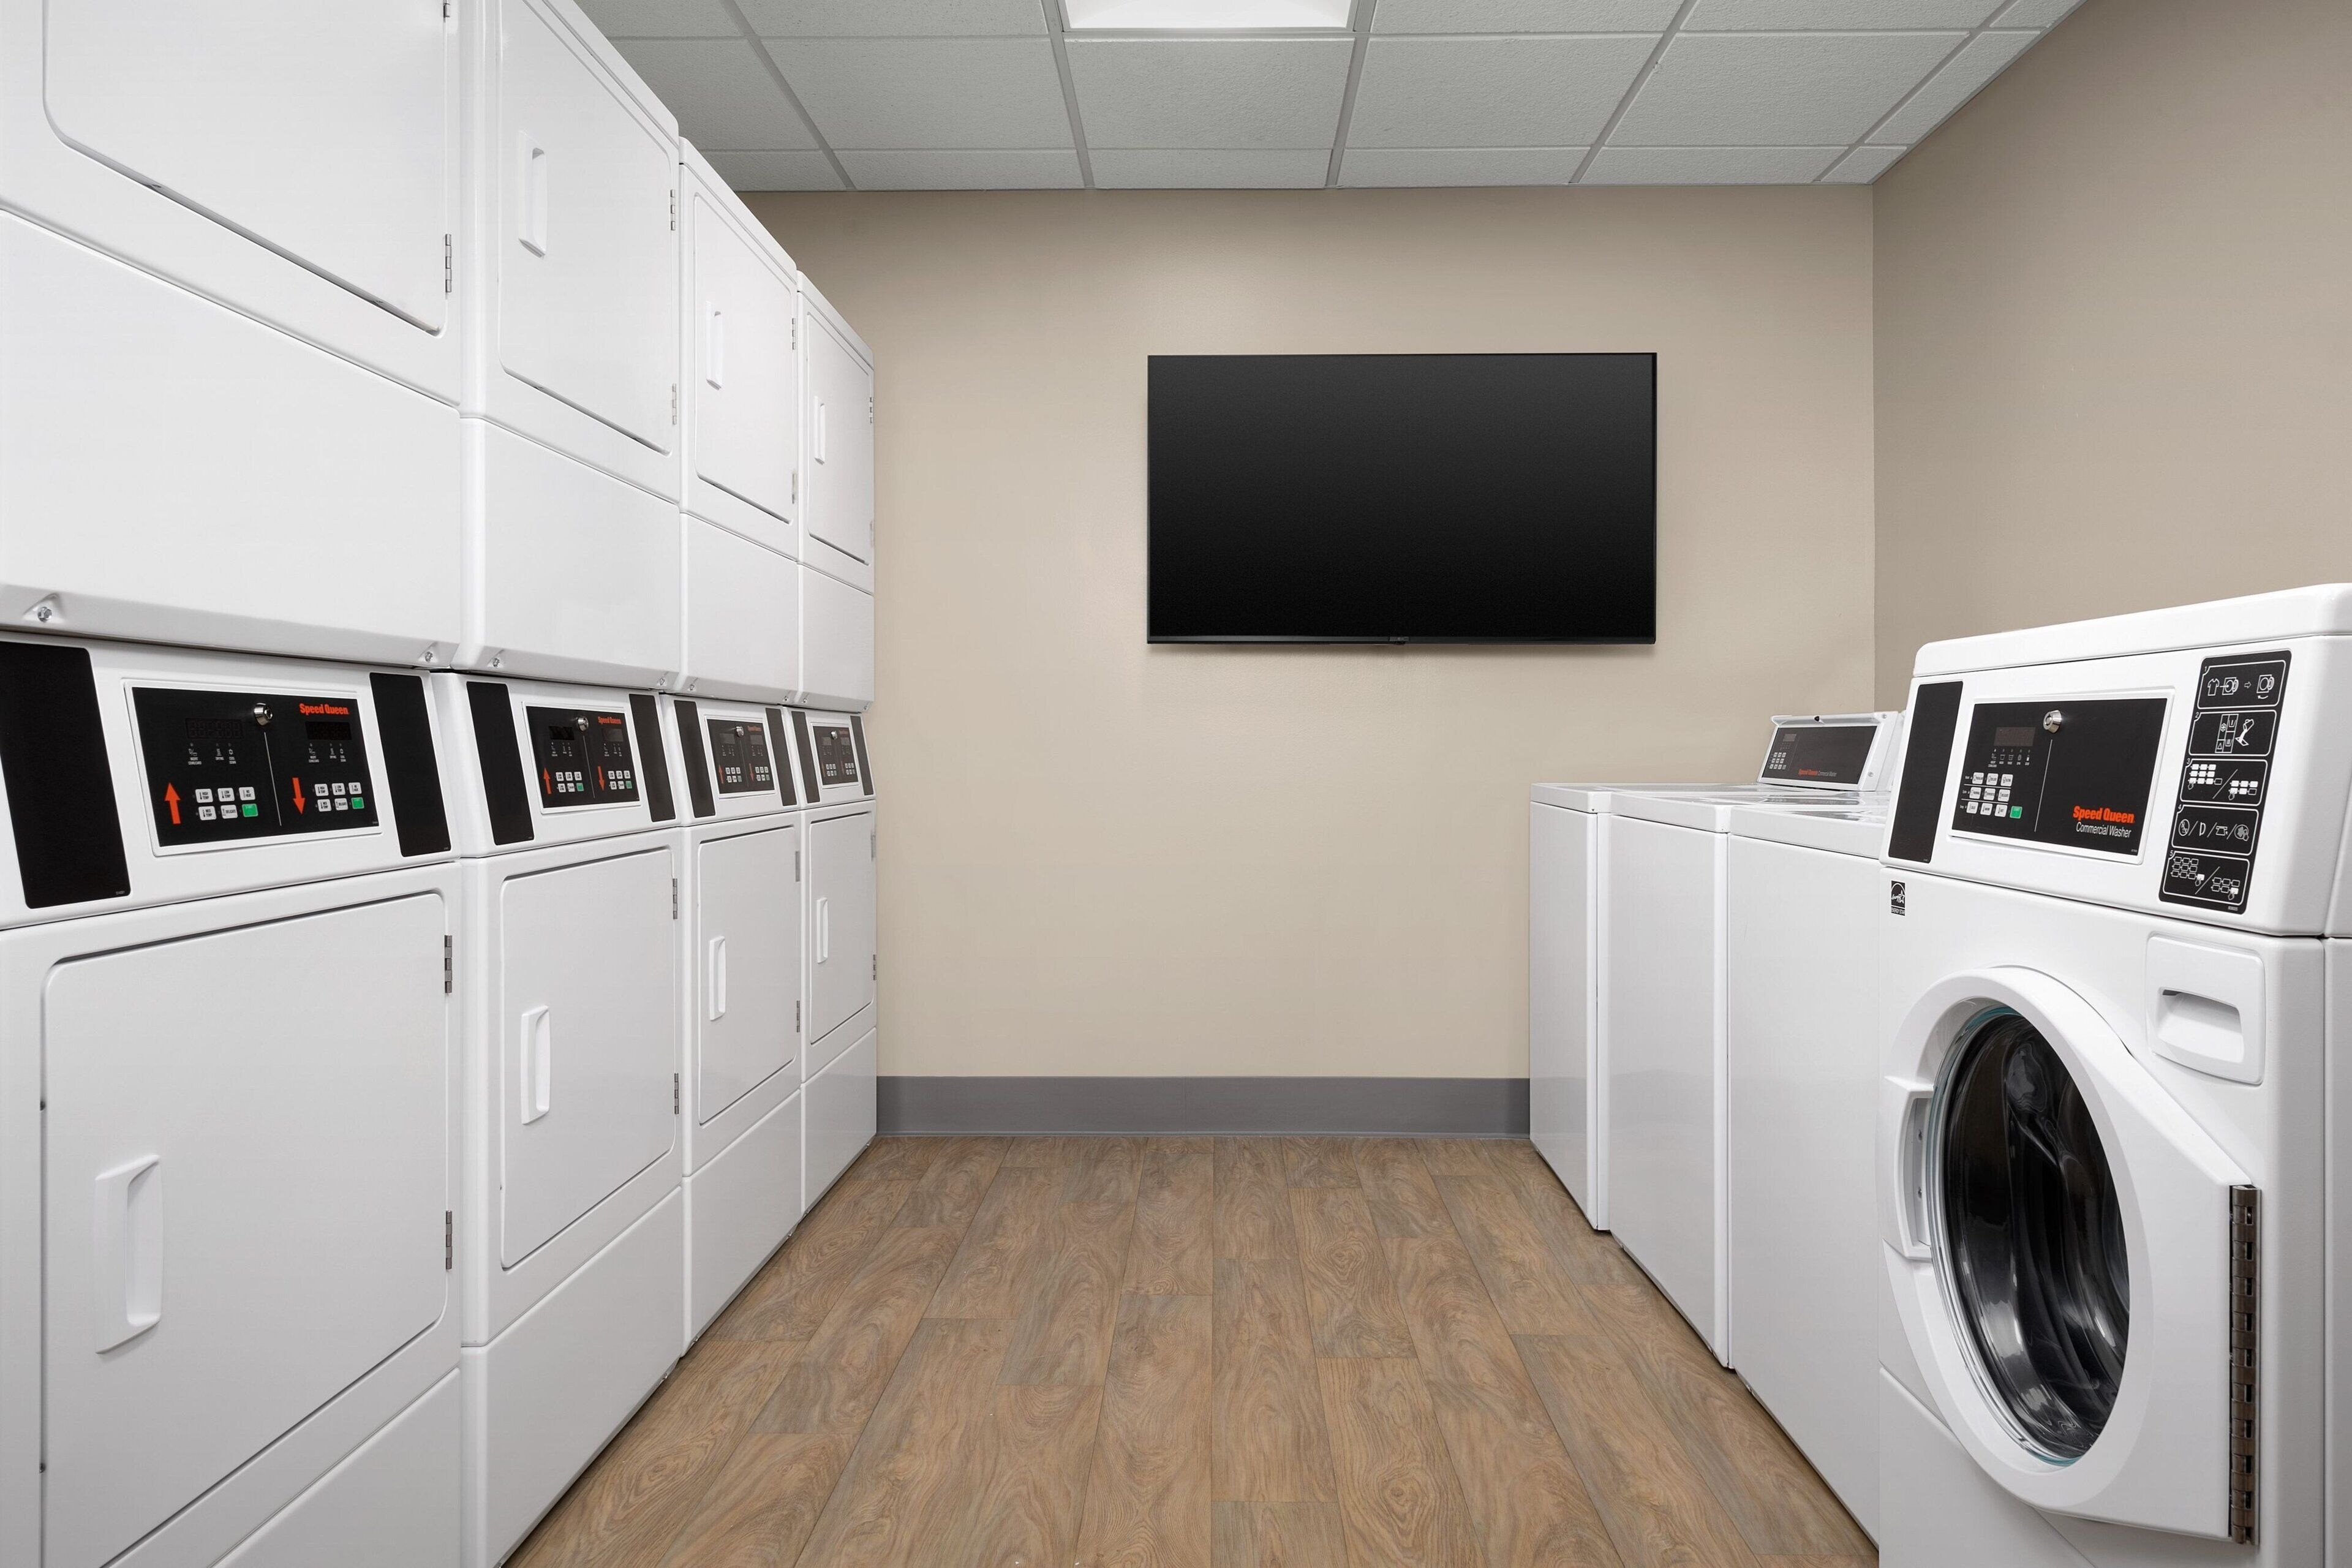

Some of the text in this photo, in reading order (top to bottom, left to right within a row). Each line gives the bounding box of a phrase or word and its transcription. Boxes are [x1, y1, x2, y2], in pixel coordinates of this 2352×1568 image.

[300, 703, 349, 715] Speed Queen
[2073, 805, 2135, 823] Speed Queen
[2076, 821, 2132, 838] Commercial Washer
